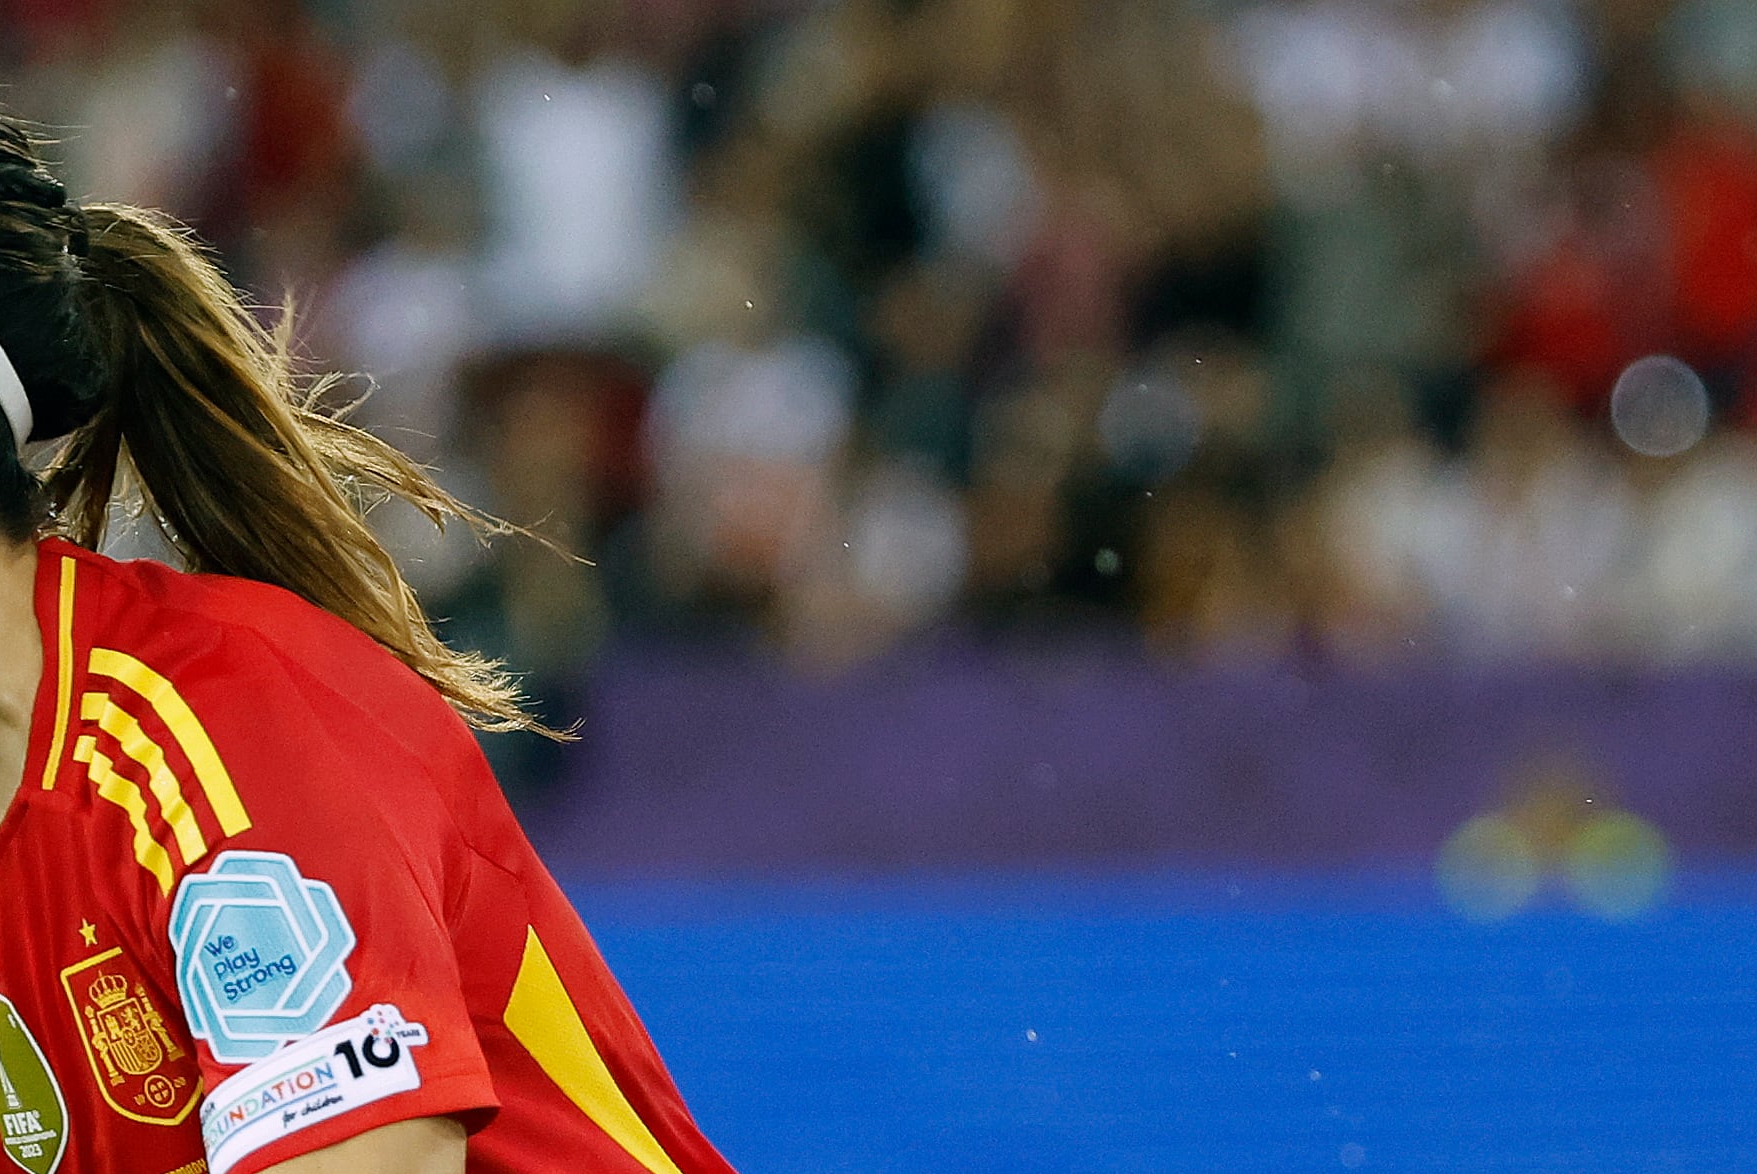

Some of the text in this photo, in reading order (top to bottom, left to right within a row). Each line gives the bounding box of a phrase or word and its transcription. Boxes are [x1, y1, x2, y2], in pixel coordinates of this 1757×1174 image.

[204, 936, 234, 956] We
[224, 954, 296, 1000] Strong
[334, 1031, 400, 1080] 10
[3, 1110, 43, 1136] FIFA
[19, 1143, 43, 1159] 2023
